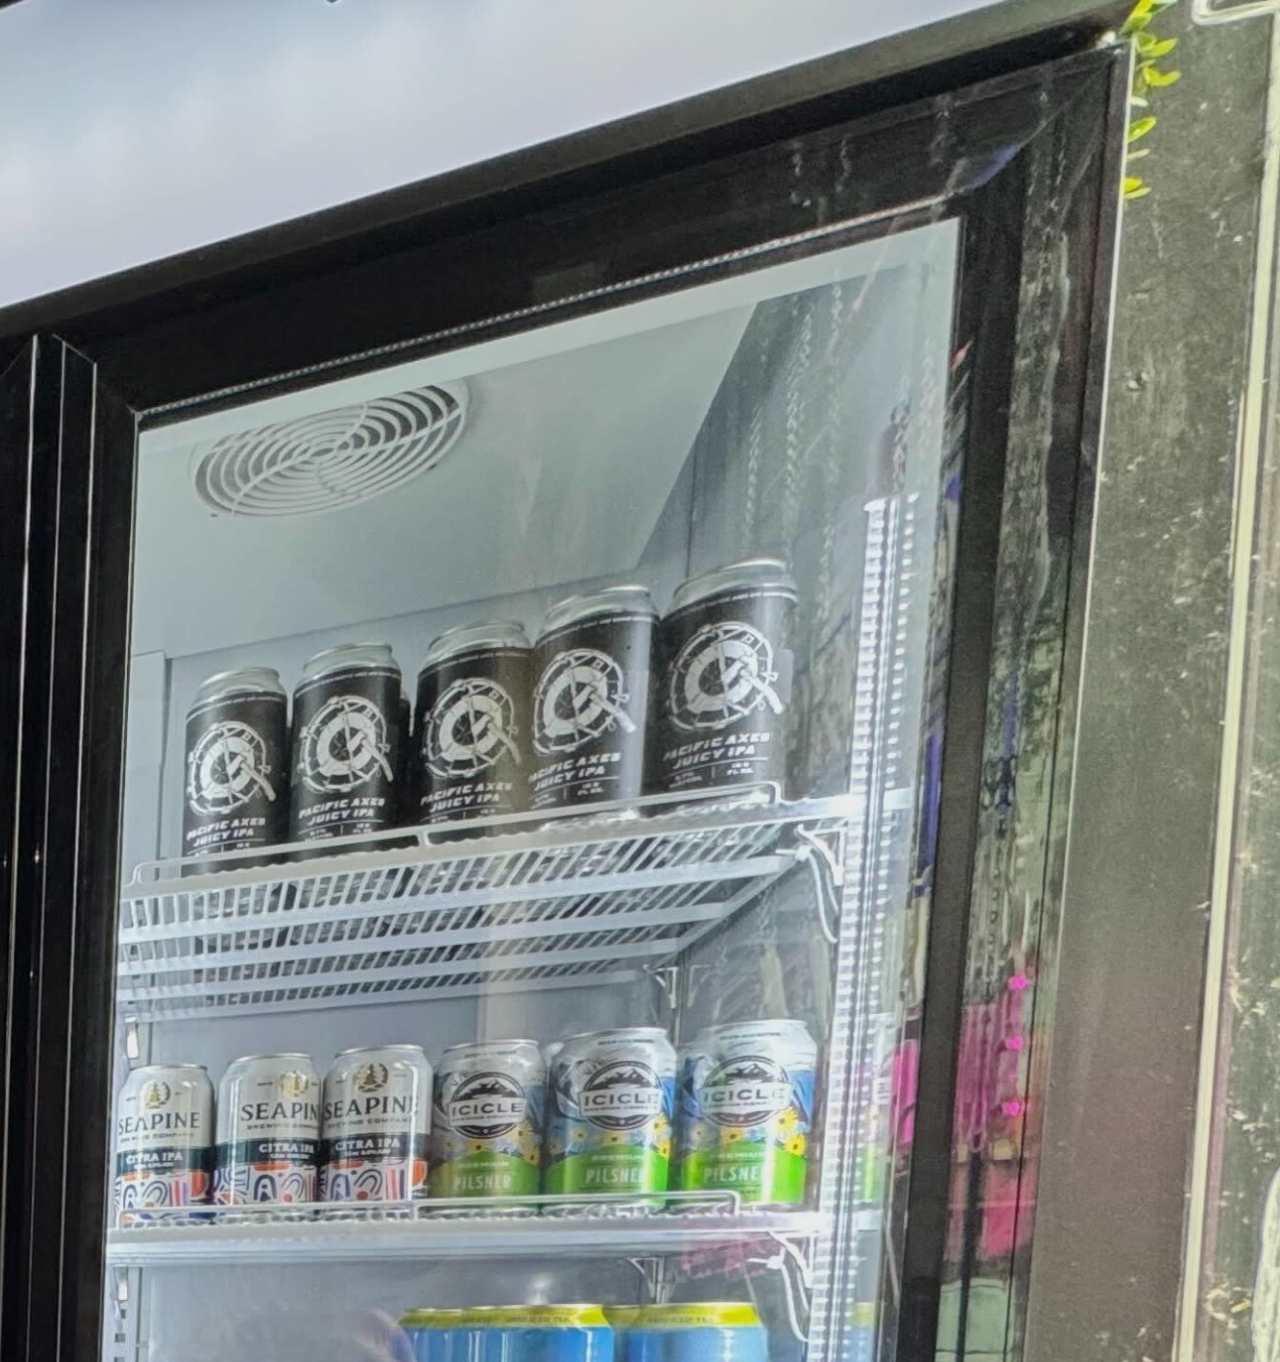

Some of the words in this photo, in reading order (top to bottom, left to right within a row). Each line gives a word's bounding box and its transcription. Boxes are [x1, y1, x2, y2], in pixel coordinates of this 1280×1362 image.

[725, 732, 771, 744] AXES
[576, 752, 622, 767] AXES
[673, 747, 725, 770] JUICY
[727, 745, 756, 757] IPA
[534, 771, 576, 792] JUICY
[577, 766, 606, 779] IPA
[420, 784, 474, 807] PACIFIC
[474, 782, 513, 793] AXES
[429, 796, 475, 813] JUICY
[476, 793, 500, 803] IPA
[298, 799, 349, 819] PACIFIC
[350, 797, 386, 808] AXES
[307, 808, 350, 826] JUICY
[352, 808, 375, 818] IPA
[231, 817, 266, 828] AXES
[193, 832, 231, 848] JUICY
[233, 828, 255, 838] IPA
[451, 1101, 525, 1119] ICICLE
[118, 1111, 201, 1136] SEAPINE
[258, 1142, 298, 1154] CITRA
[335, 1138, 375, 1151] CITRA
[377, 1137, 401, 1149] IPA
[126, 1151, 160, 1164] CITRA
[161, 1150, 184, 1162] IPA
[453, 1174, 512, 1191] PILSNER
